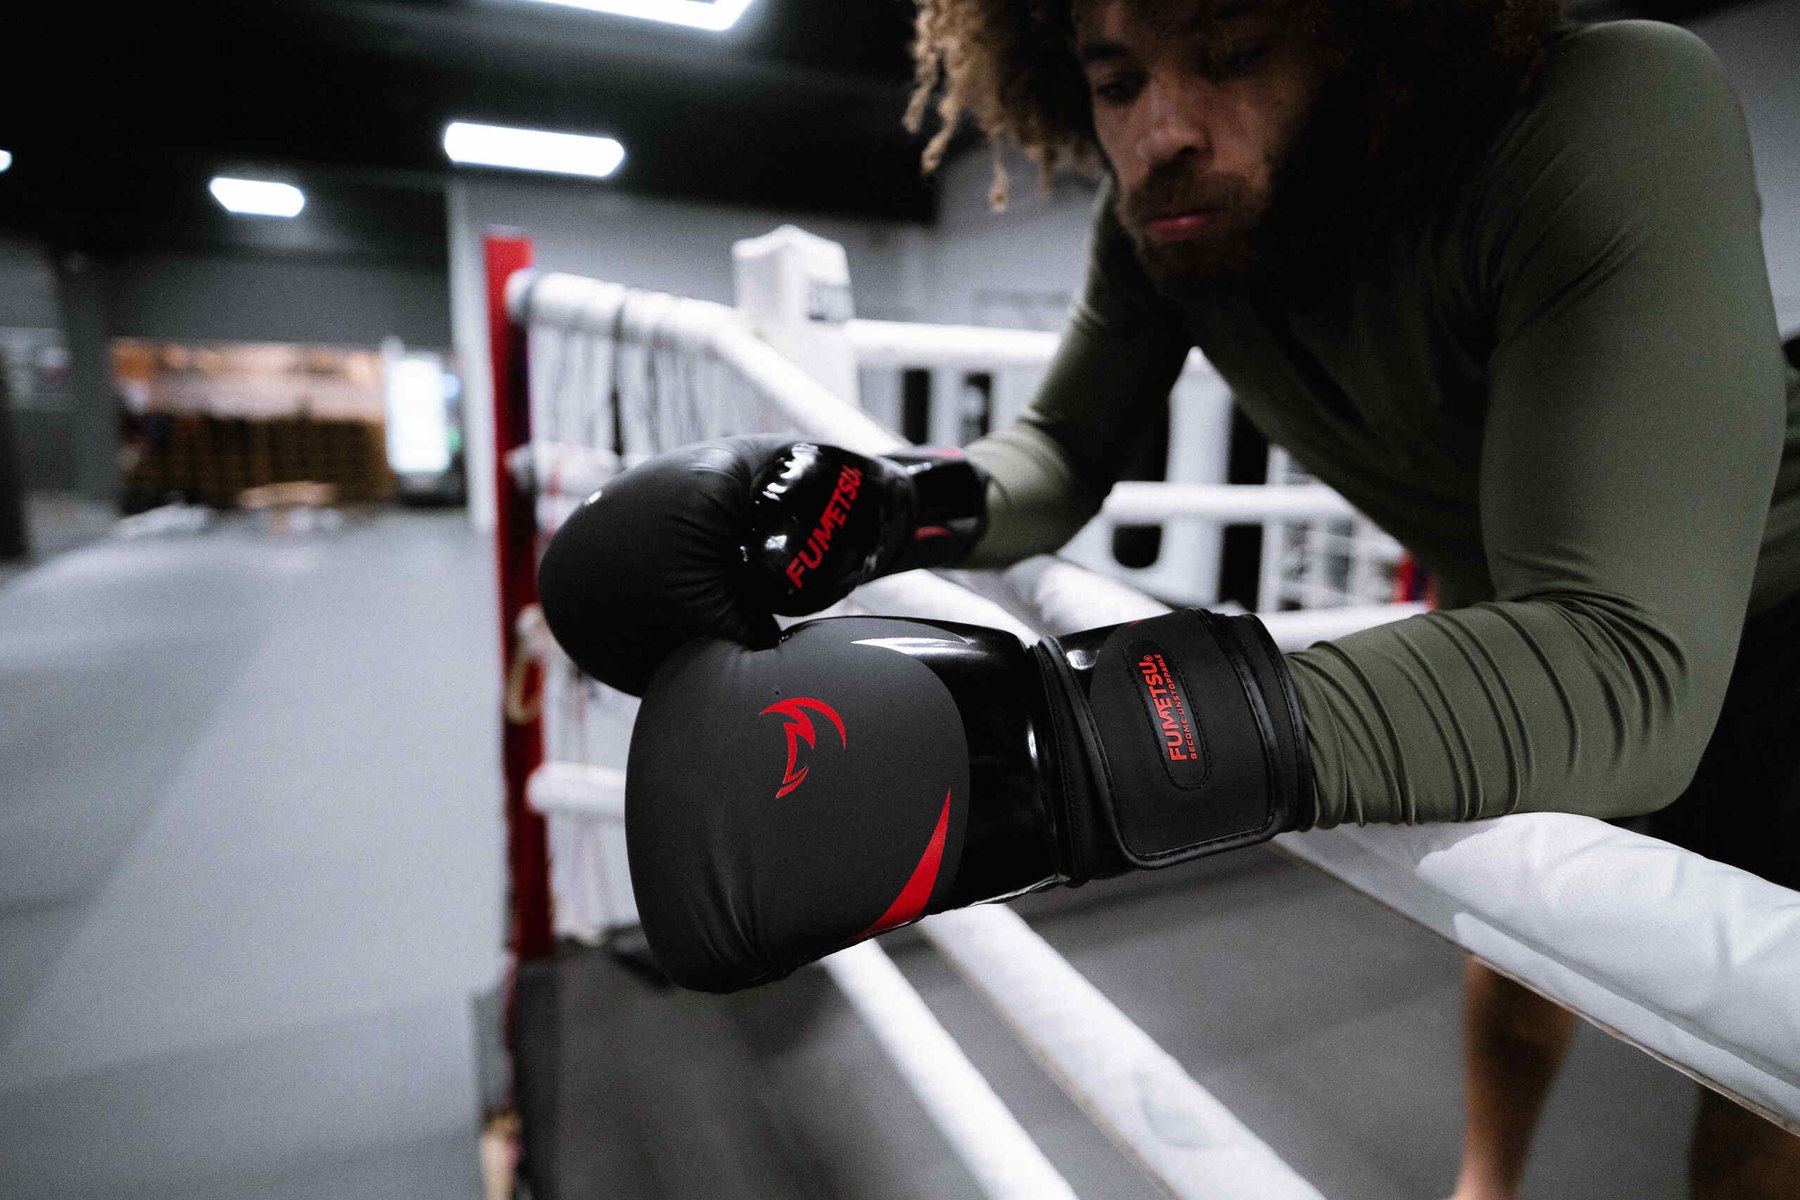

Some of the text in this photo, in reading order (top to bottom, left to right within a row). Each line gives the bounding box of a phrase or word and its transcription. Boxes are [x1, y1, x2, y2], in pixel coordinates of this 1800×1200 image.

[785, 465, 862, 589] FUMETSU
[1154, 653, 1198, 760] BECOME UNSTOPPABLE
